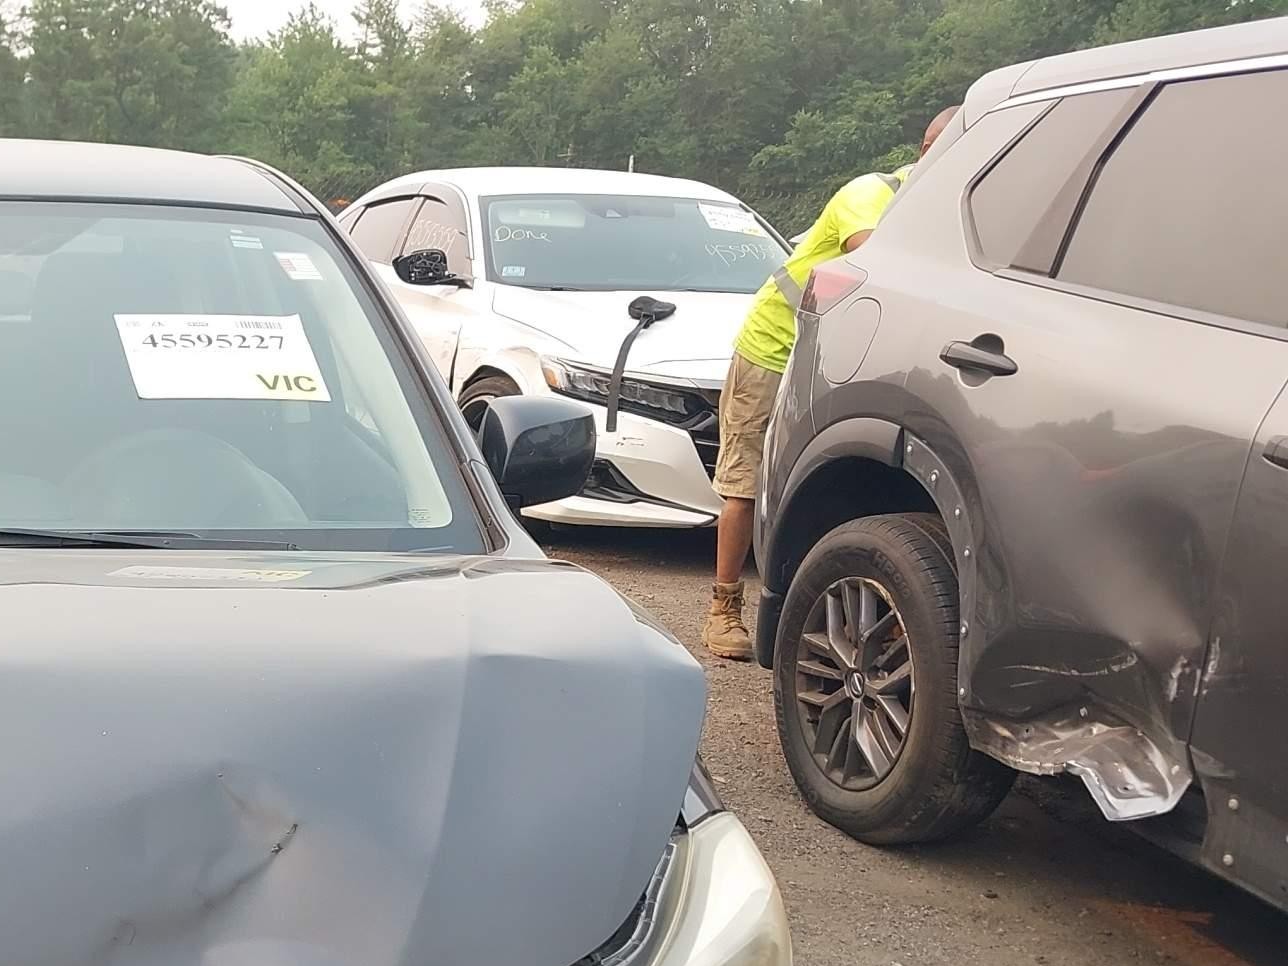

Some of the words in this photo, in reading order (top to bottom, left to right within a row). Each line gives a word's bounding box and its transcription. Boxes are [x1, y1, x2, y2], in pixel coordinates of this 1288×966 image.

[494, 225, 553, 243] Done
[142, 333, 284, 350] 45595227
[256, 374, 318, 392] VIC
